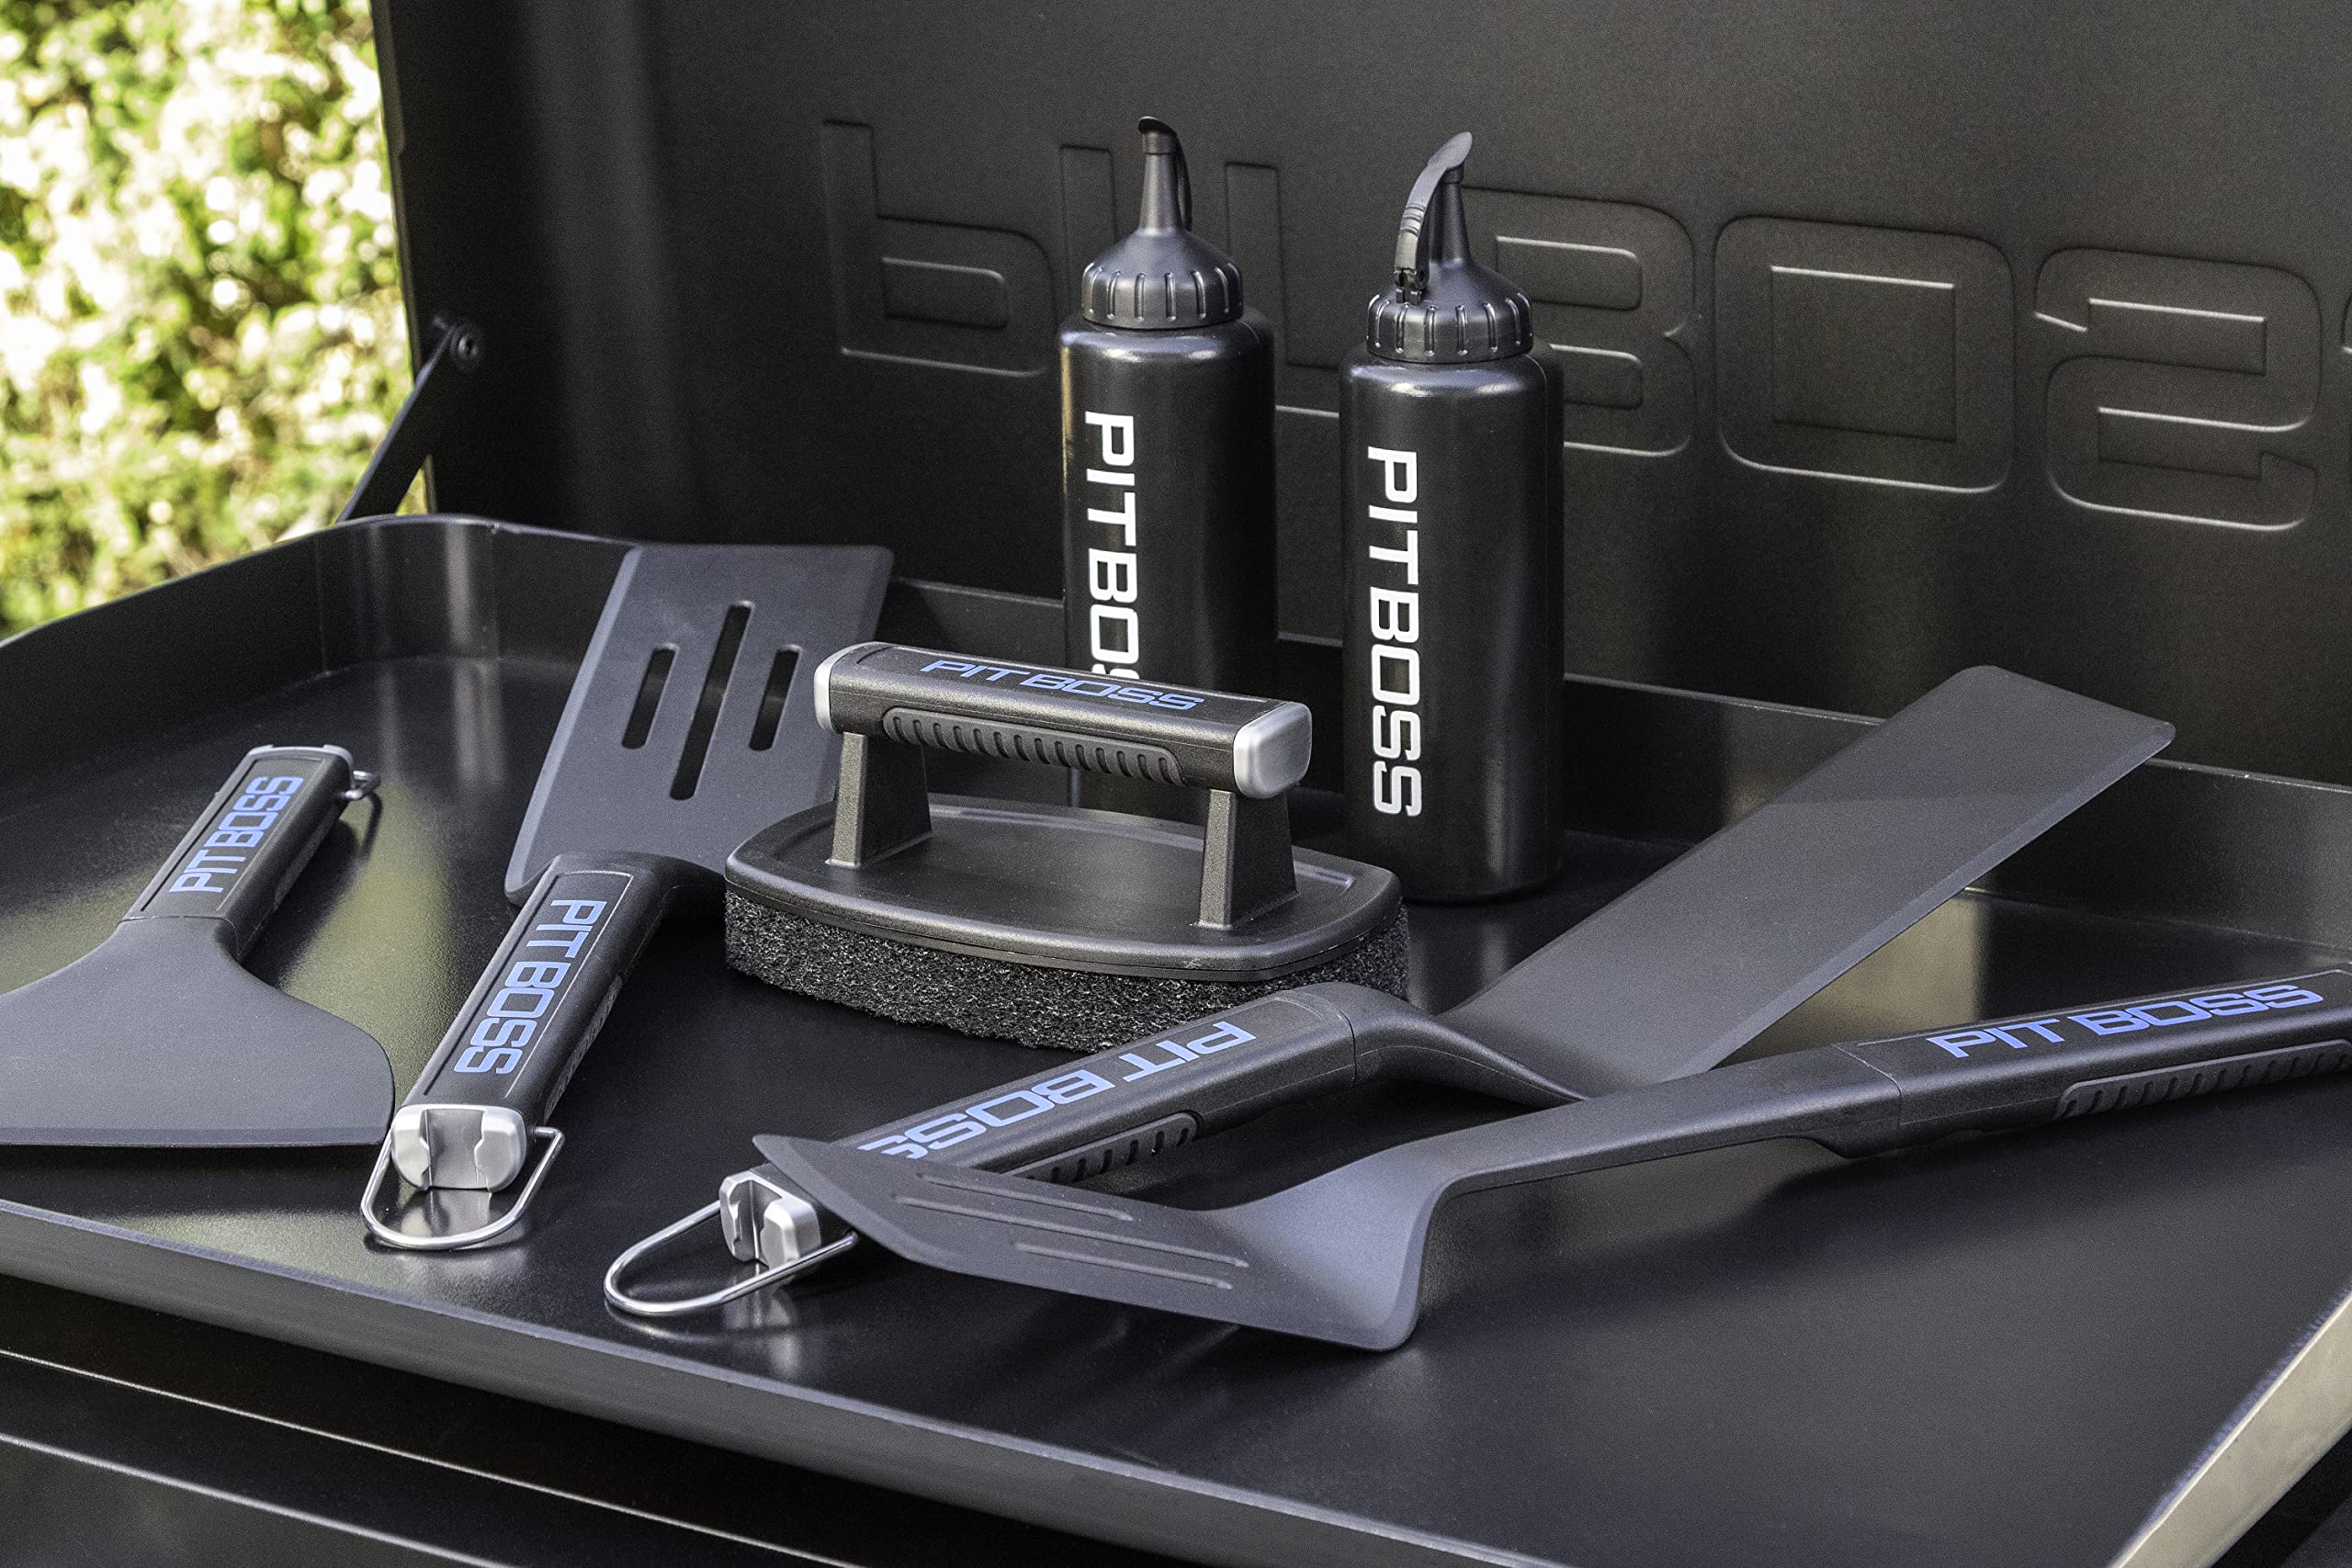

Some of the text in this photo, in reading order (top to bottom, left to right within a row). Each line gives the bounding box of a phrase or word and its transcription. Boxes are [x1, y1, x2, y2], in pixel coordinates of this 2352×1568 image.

[1085, 411, 1140, 680] PITBO
[1118, 1021, 1257, 1083] PIT
[1926, 984, 2324, 1058] PIT BOSS
